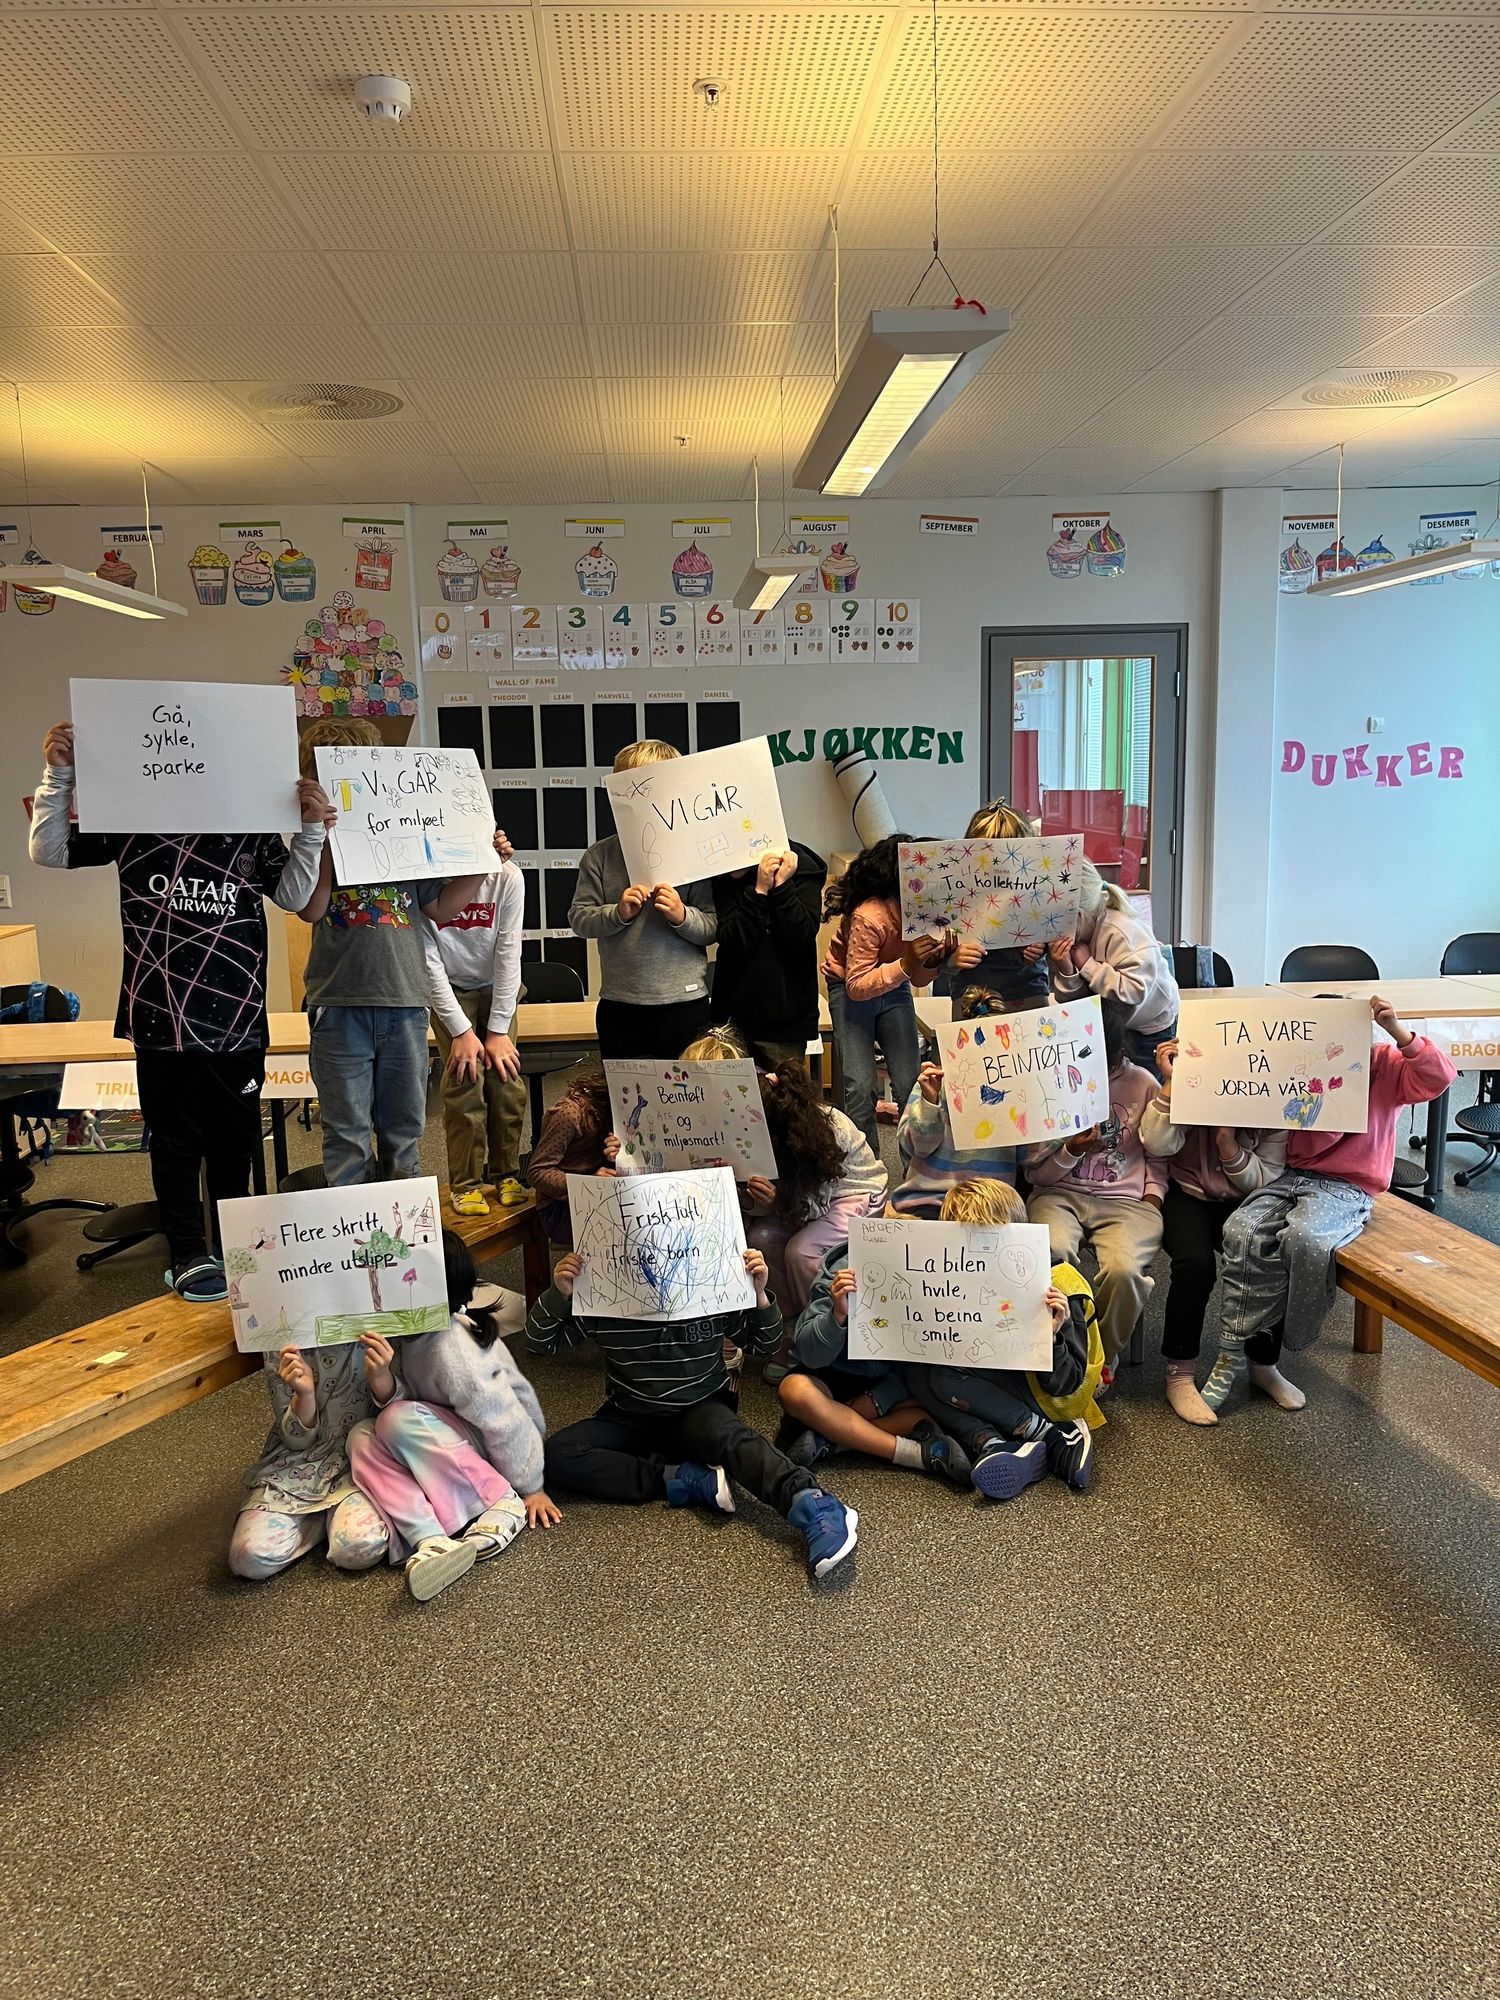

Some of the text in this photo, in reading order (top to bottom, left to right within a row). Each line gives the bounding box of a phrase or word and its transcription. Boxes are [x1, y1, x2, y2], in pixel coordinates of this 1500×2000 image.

[237, 529, 264, 538] MARS
[361, 526, 386, 535] APRIL
[469, 528, 487, 537] MAI
[585, 526, 604, 534] JUNI
[693, 526, 710, 535] JULI
[802, 523, 837, 532] AUGUST
[925, 521, 973, 533] SEPTEMBER
[1063, 520, 1101, 528] OKTOBER
[1288, 522, 1335, 531] NOVEMBER
[1427, 519, 1470, 529] DESEMBER
[479, 608, 490, 629] 1
[522, 607, 541, 628] 2
[568, 607, 587, 628] 3
[612, 605, 631, 626] 4
[659, 605, 677, 626] 5
[706, 604, 724, 625] 6
[795, 602, 813, 624] 8
[841, 600, 859, 621] 9
[887, 602, 909, 622] 10
[495, 679, 517, 687] WALL
[152, 704, 191, 727] Gå,
[141, 729, 195, 754] sykle,
[767, 726, 964, 767] KJØKKEN
[142, 758, 206, 780] sparke
[1281, 741, 1464, 787] DUKKER
[368, 808, 445, 835] for miljøet
[148, 874, 237, 904] QATAR
[941, 874, 966, 890] Ta
[974, 874, 1038, 891] kollektivt
[167, 898, 237, 917] AIRWAYS
[1215, 1020, 1317, 1046] TA VARE
[1451, 1043, 1500, 1056] BRAG
[983, 1040, 1079, 1085] BEINTØFT
[1248, 1049, 1271, 1073] PÅ
[657, 1085, 705, 1104] Beintøft
[1215, 1077, 1311, 1097] JORDA VÅR
[664, 1132, 725, 1151] miljøsmart!
[619, 1200, 671, 1231] Frisk
[280, 1211, 384, 1246] Flere skritt,
[278, 1249, 394, 1283] mindre utslipp
[611, 1244, 700, 1268] friske barn
[905, 1244, 986, 1273] La bilen
[922, 1280, 966, 1300] hvile,
[906, 1305, 982, 1322] la beina
[685, 1319, 714, 1343] 89
[922, 1327, 962, 1343] smile
